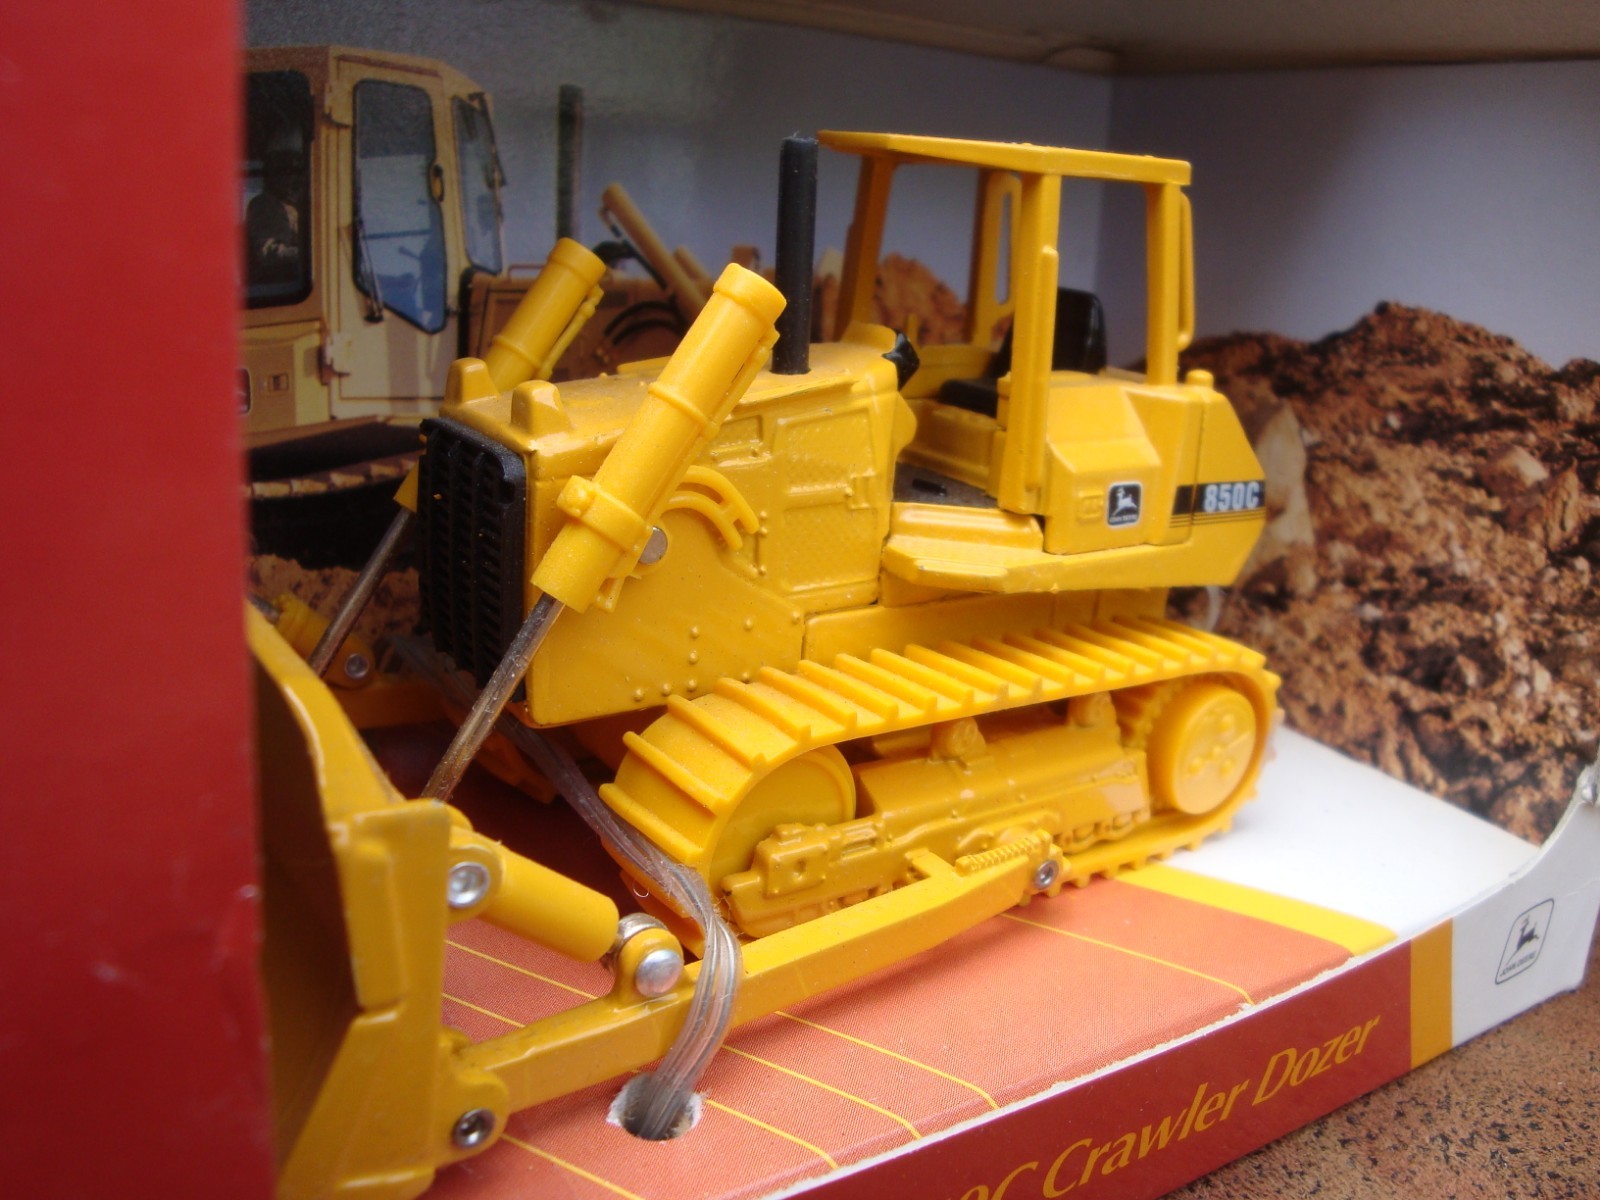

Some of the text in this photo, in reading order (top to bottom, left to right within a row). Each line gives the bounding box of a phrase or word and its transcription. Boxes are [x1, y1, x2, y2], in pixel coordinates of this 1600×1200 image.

[1203, 481, 1260, 513] 850C
[1042, 1079, 1250, 1199] Crawler
[1252, 1015, 1381, 1106] Dozer
